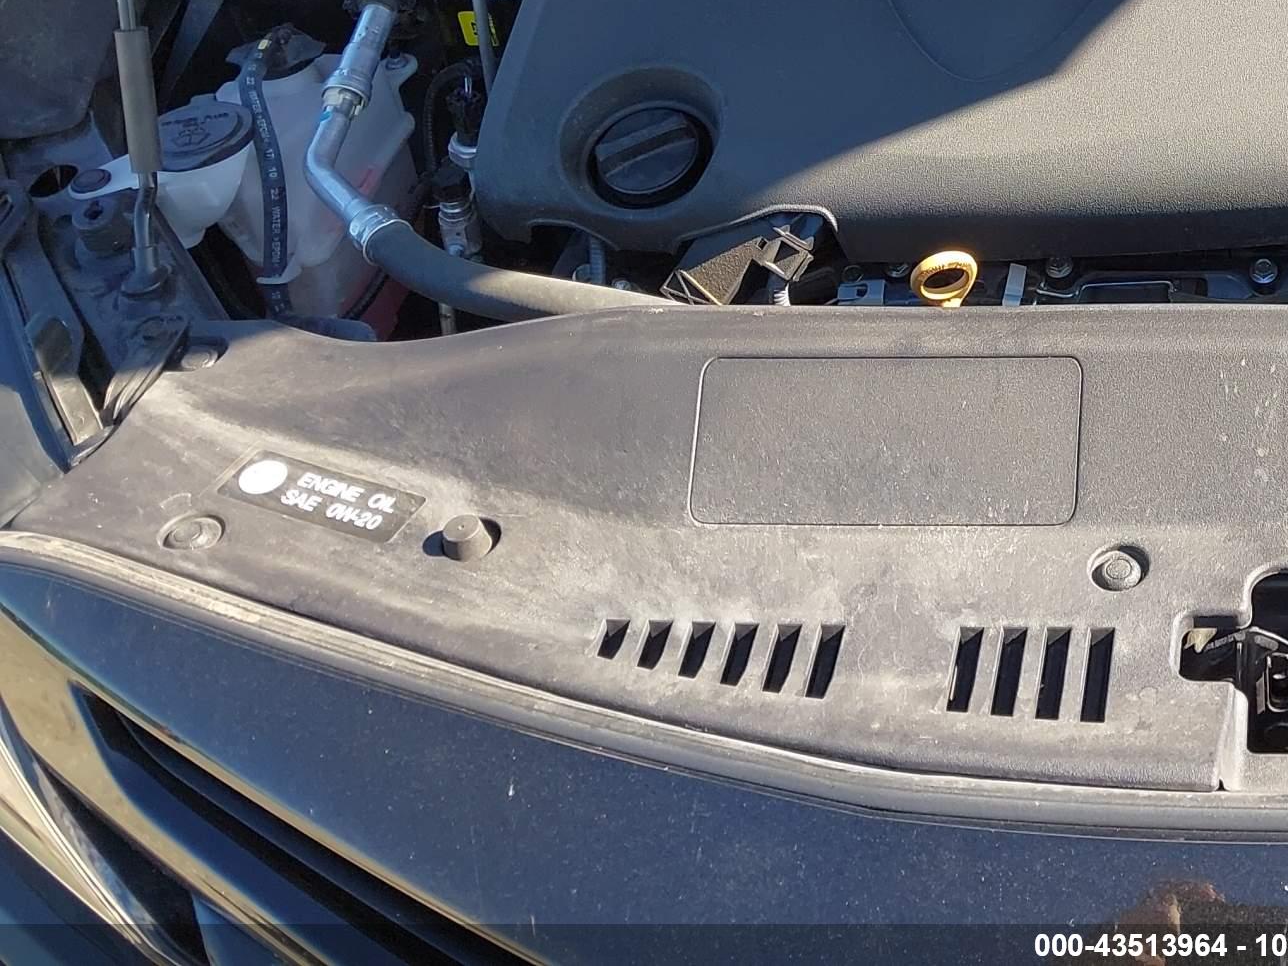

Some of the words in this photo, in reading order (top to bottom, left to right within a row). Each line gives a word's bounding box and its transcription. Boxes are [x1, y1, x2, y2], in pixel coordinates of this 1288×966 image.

[270, 205, 281, 235] WATER
[280, 489, 324, 512] SAE
[325, 502, 383, 531] 0W-20
[296, 471, 365, 503] ENGINE
[367, 492, 398, 514] OIL
